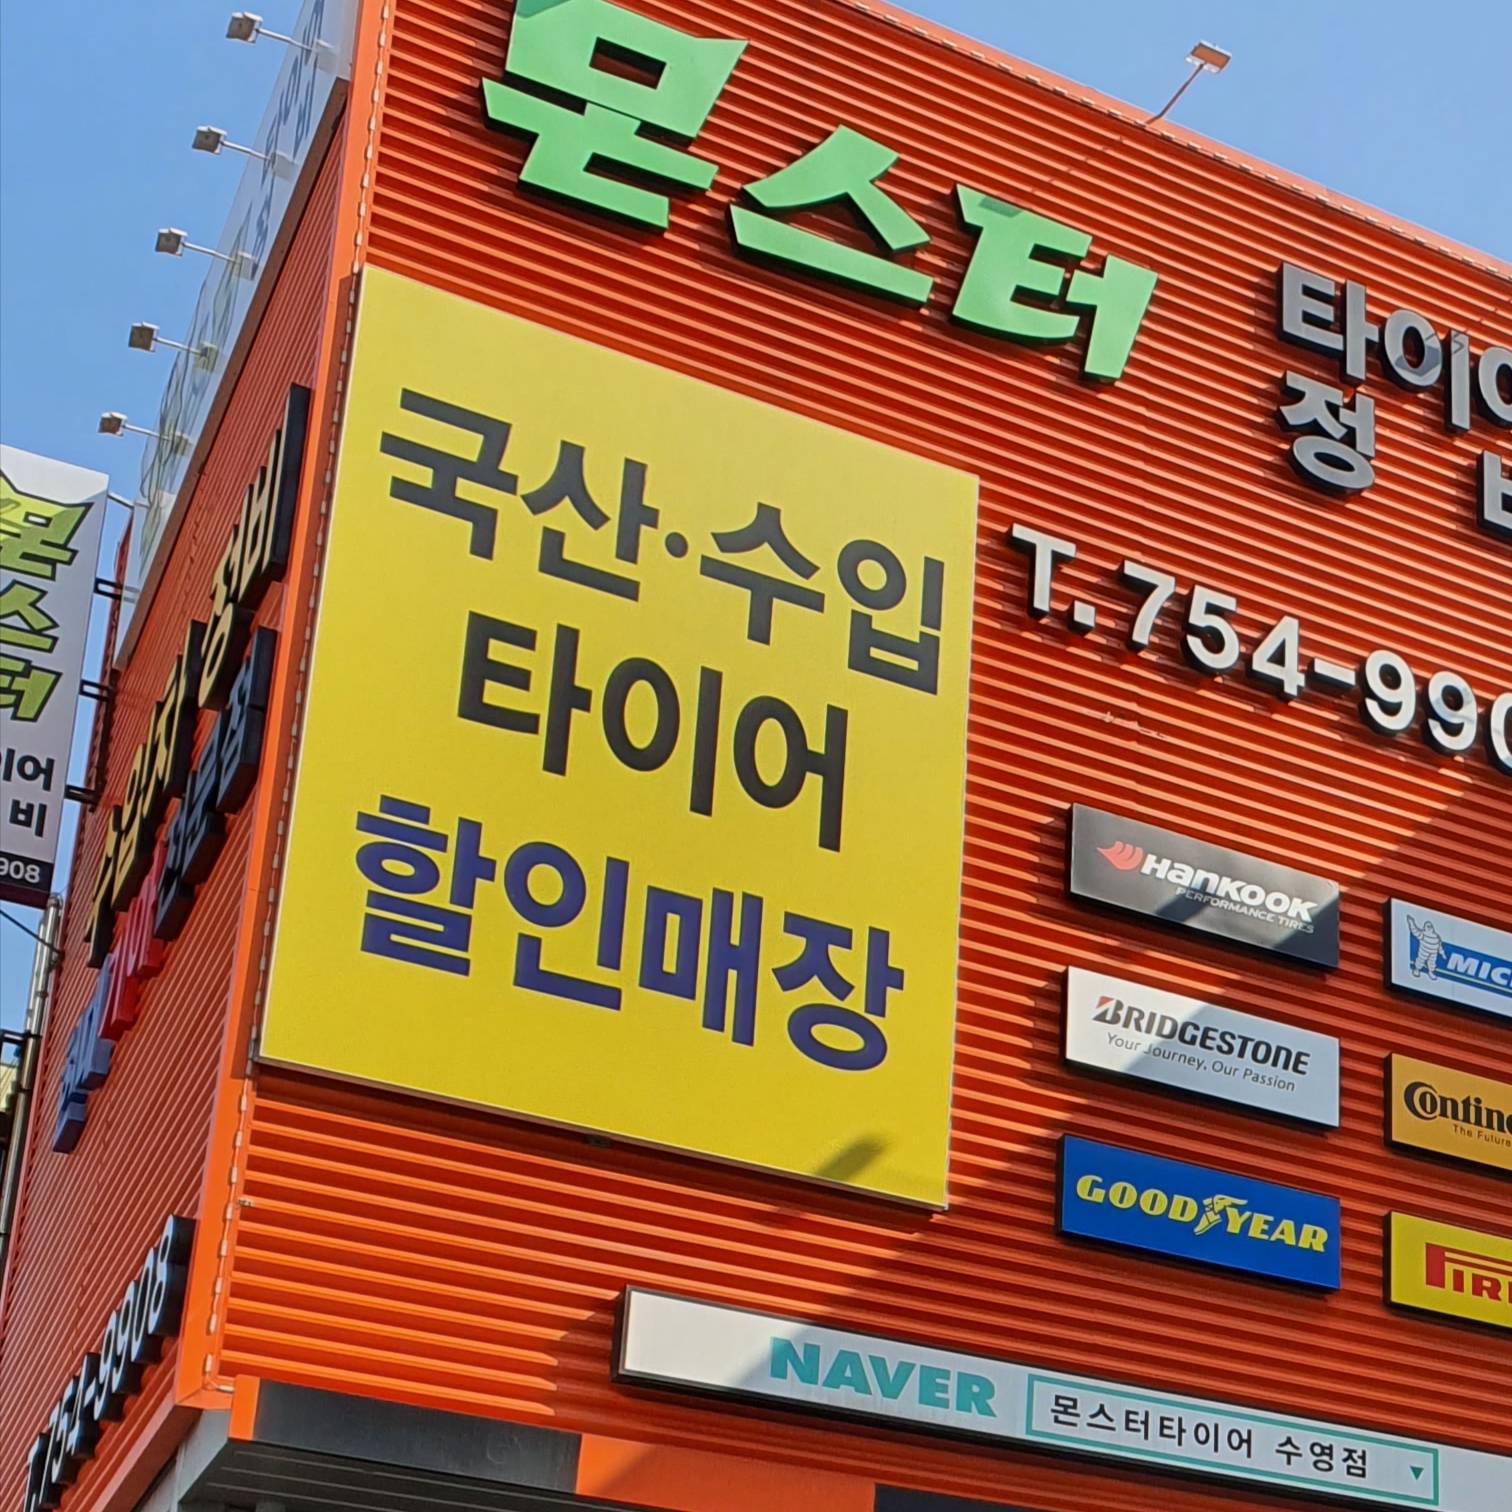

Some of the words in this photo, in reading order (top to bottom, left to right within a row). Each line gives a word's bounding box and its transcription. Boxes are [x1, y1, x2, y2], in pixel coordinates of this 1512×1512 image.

[482, 0, 1158, 379] 몬스터
[1278, 370, 1376, 493] 정
[457, 610, 849, 853] 타이어
[9, 799, 47, 837] 비
[355, 794, 904, 1071] 할인매장
[1176, 887, 1274, 923] PERFORMANCE
[1277, 914, 1315, 934] TIRES
[1091, 995, 1311, 1076] BRIDGESTONE
[1107, 1032, 1141, 1052] Your
[1211, 1060, 1239, 1077] Our
[1242, 1068, 1296, 1092] Passion
[1453, 1124, 1473, 1138] The
[1477, 1131, 1512, 1148] Future
[770, 1336, 997, 1418] NAVER
[1050, 1394, 1252, 1459] 몬스터타이어
[1275, 1436, 1368, 1479] 수영점
